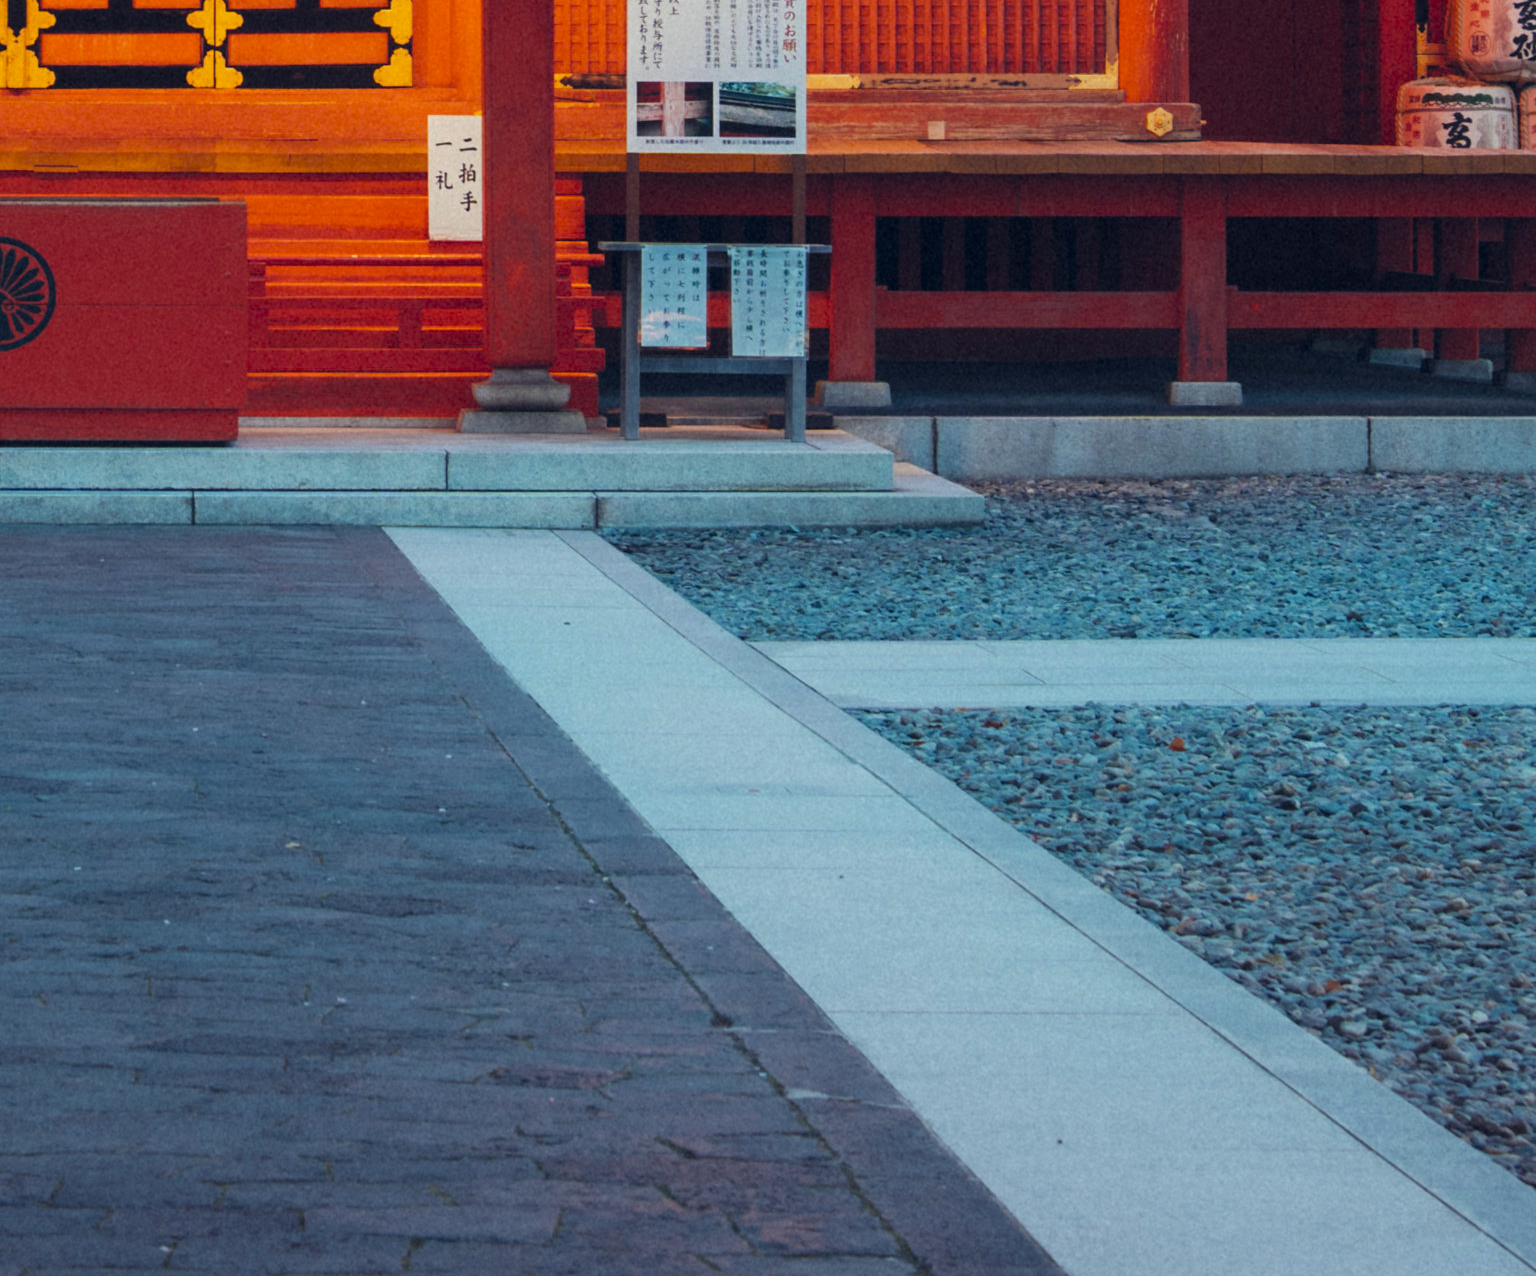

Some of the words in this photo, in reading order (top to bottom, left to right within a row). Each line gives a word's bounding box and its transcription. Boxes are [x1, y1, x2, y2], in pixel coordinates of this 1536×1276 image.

[435, 142, 453, 190] 一礼
[459, 138, 477, 212] 二拍手
